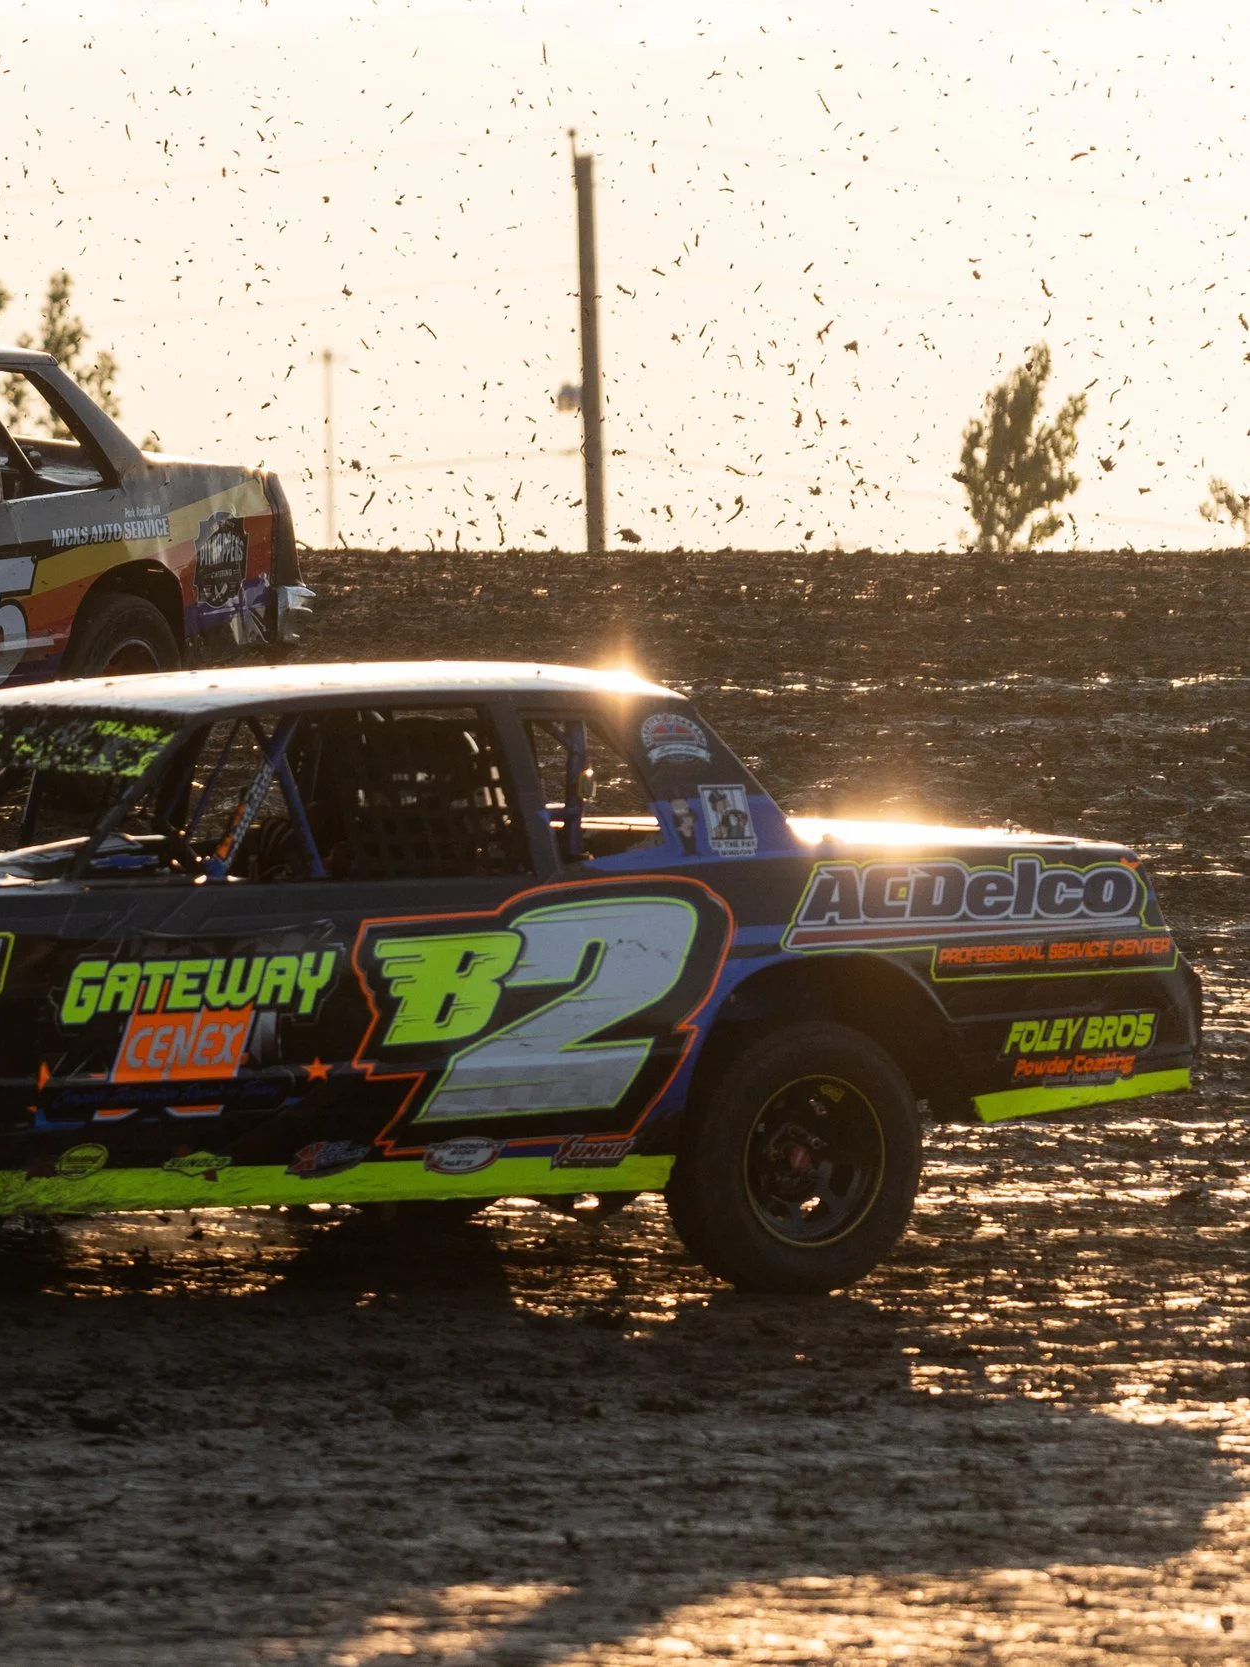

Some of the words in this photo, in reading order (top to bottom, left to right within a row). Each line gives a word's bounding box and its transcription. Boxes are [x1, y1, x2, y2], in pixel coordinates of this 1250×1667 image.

[52, 526, 89, 547] NICKS
[89, 522, 123, 544] AUTO
[124, 518, 170, 541] SERVICE
[797, 859, 1138, 926] ACDelco
[939, 943, 1044, 964] PROFESSIONAL
[1048, 940, 1110, 960] SERVICE
[1112, 936, 1171, 956] CENTER
[60, 950, 336, 1025] GATEWAY
[374, 897, 698, 1125] B2
[126, 1022, 243, 1069] CENEX
[1004, 1016, 1085, 1055] FOLEY
[1081, 1013, 1155, 1050] BROS
[1013, 1055, 1073, 1078] Powder
[1073, 1051, 1137, 1076] Coating
[553, 1134, 636, 1163] SUMMIT
